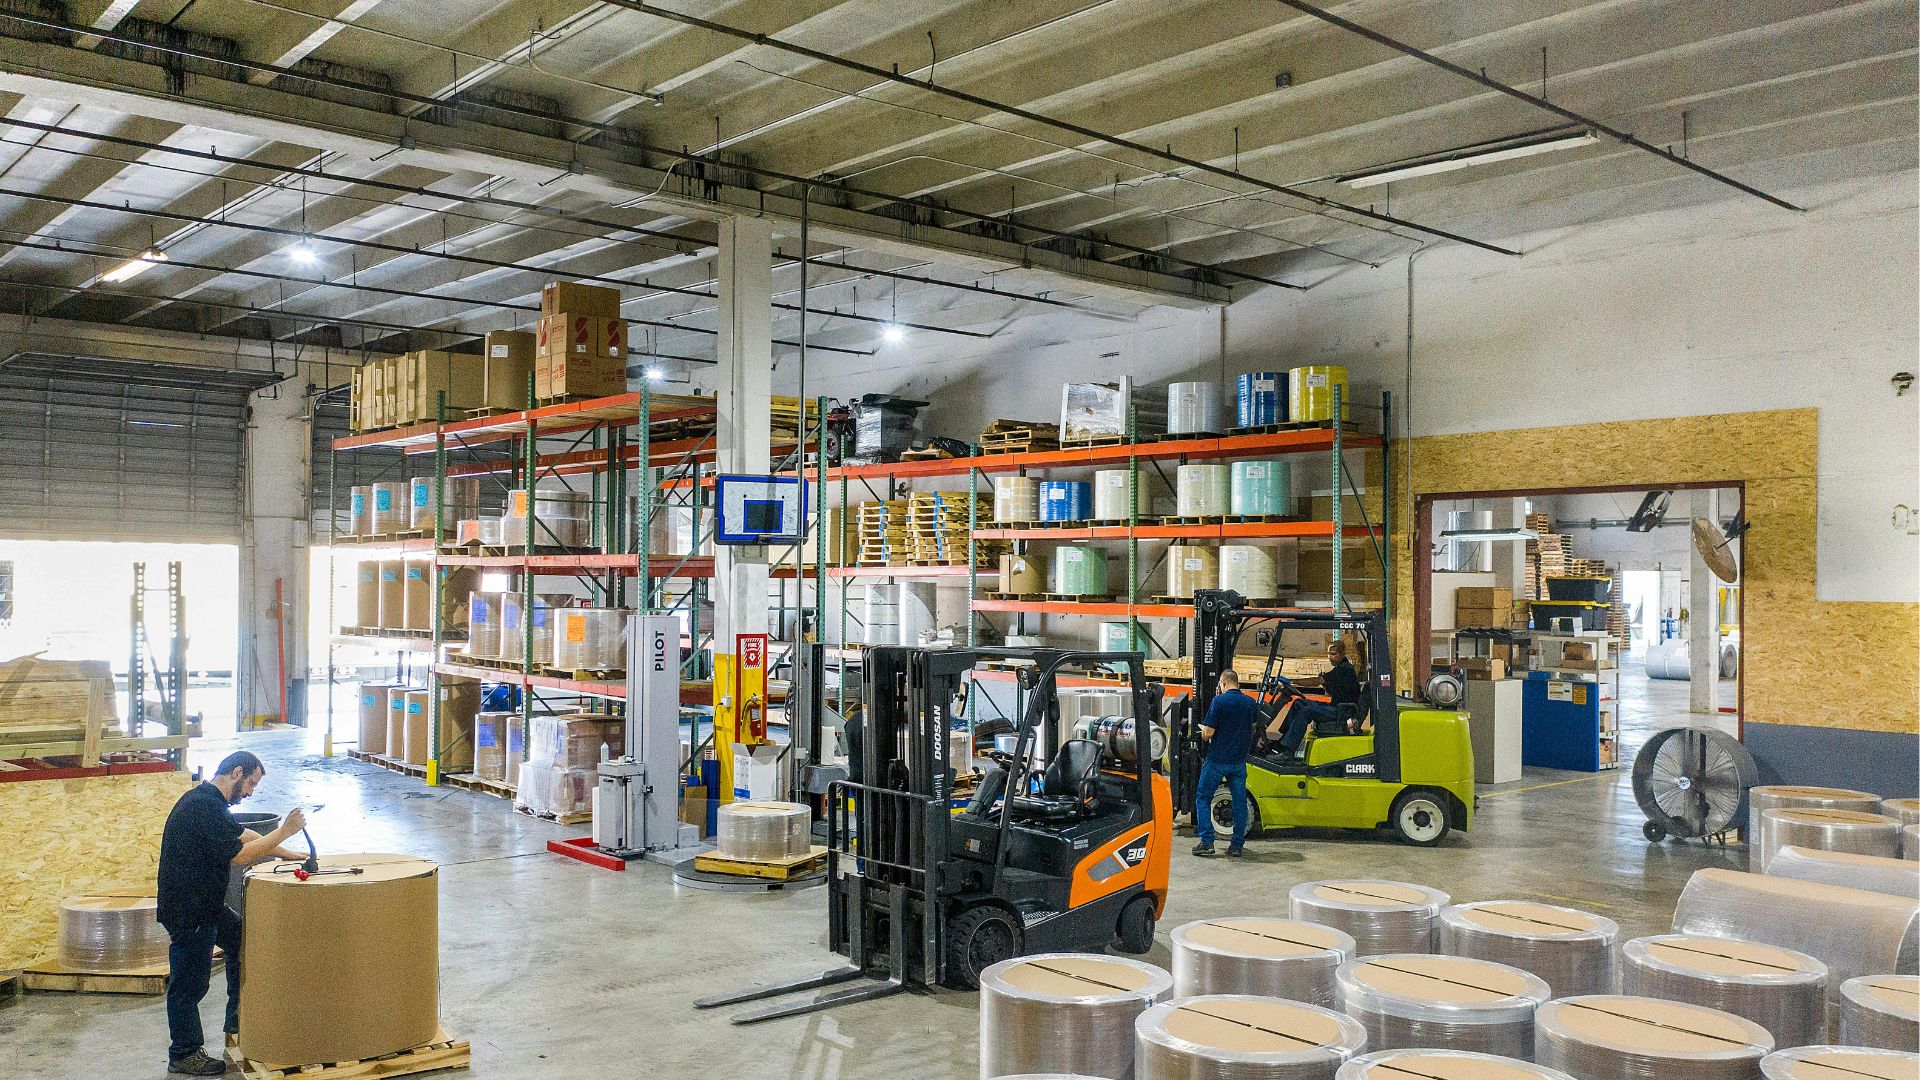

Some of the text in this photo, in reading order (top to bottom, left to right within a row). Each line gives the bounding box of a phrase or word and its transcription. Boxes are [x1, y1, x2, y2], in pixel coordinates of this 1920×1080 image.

[655, 630, 664, 671] PILOT
[1204, 635, 1213, 664] CLARK
[933, 704, 942, 761] DOOSAN
[1345, 764, 1375, 773] CLARK
[1126, 847, 1147, 861] 30
